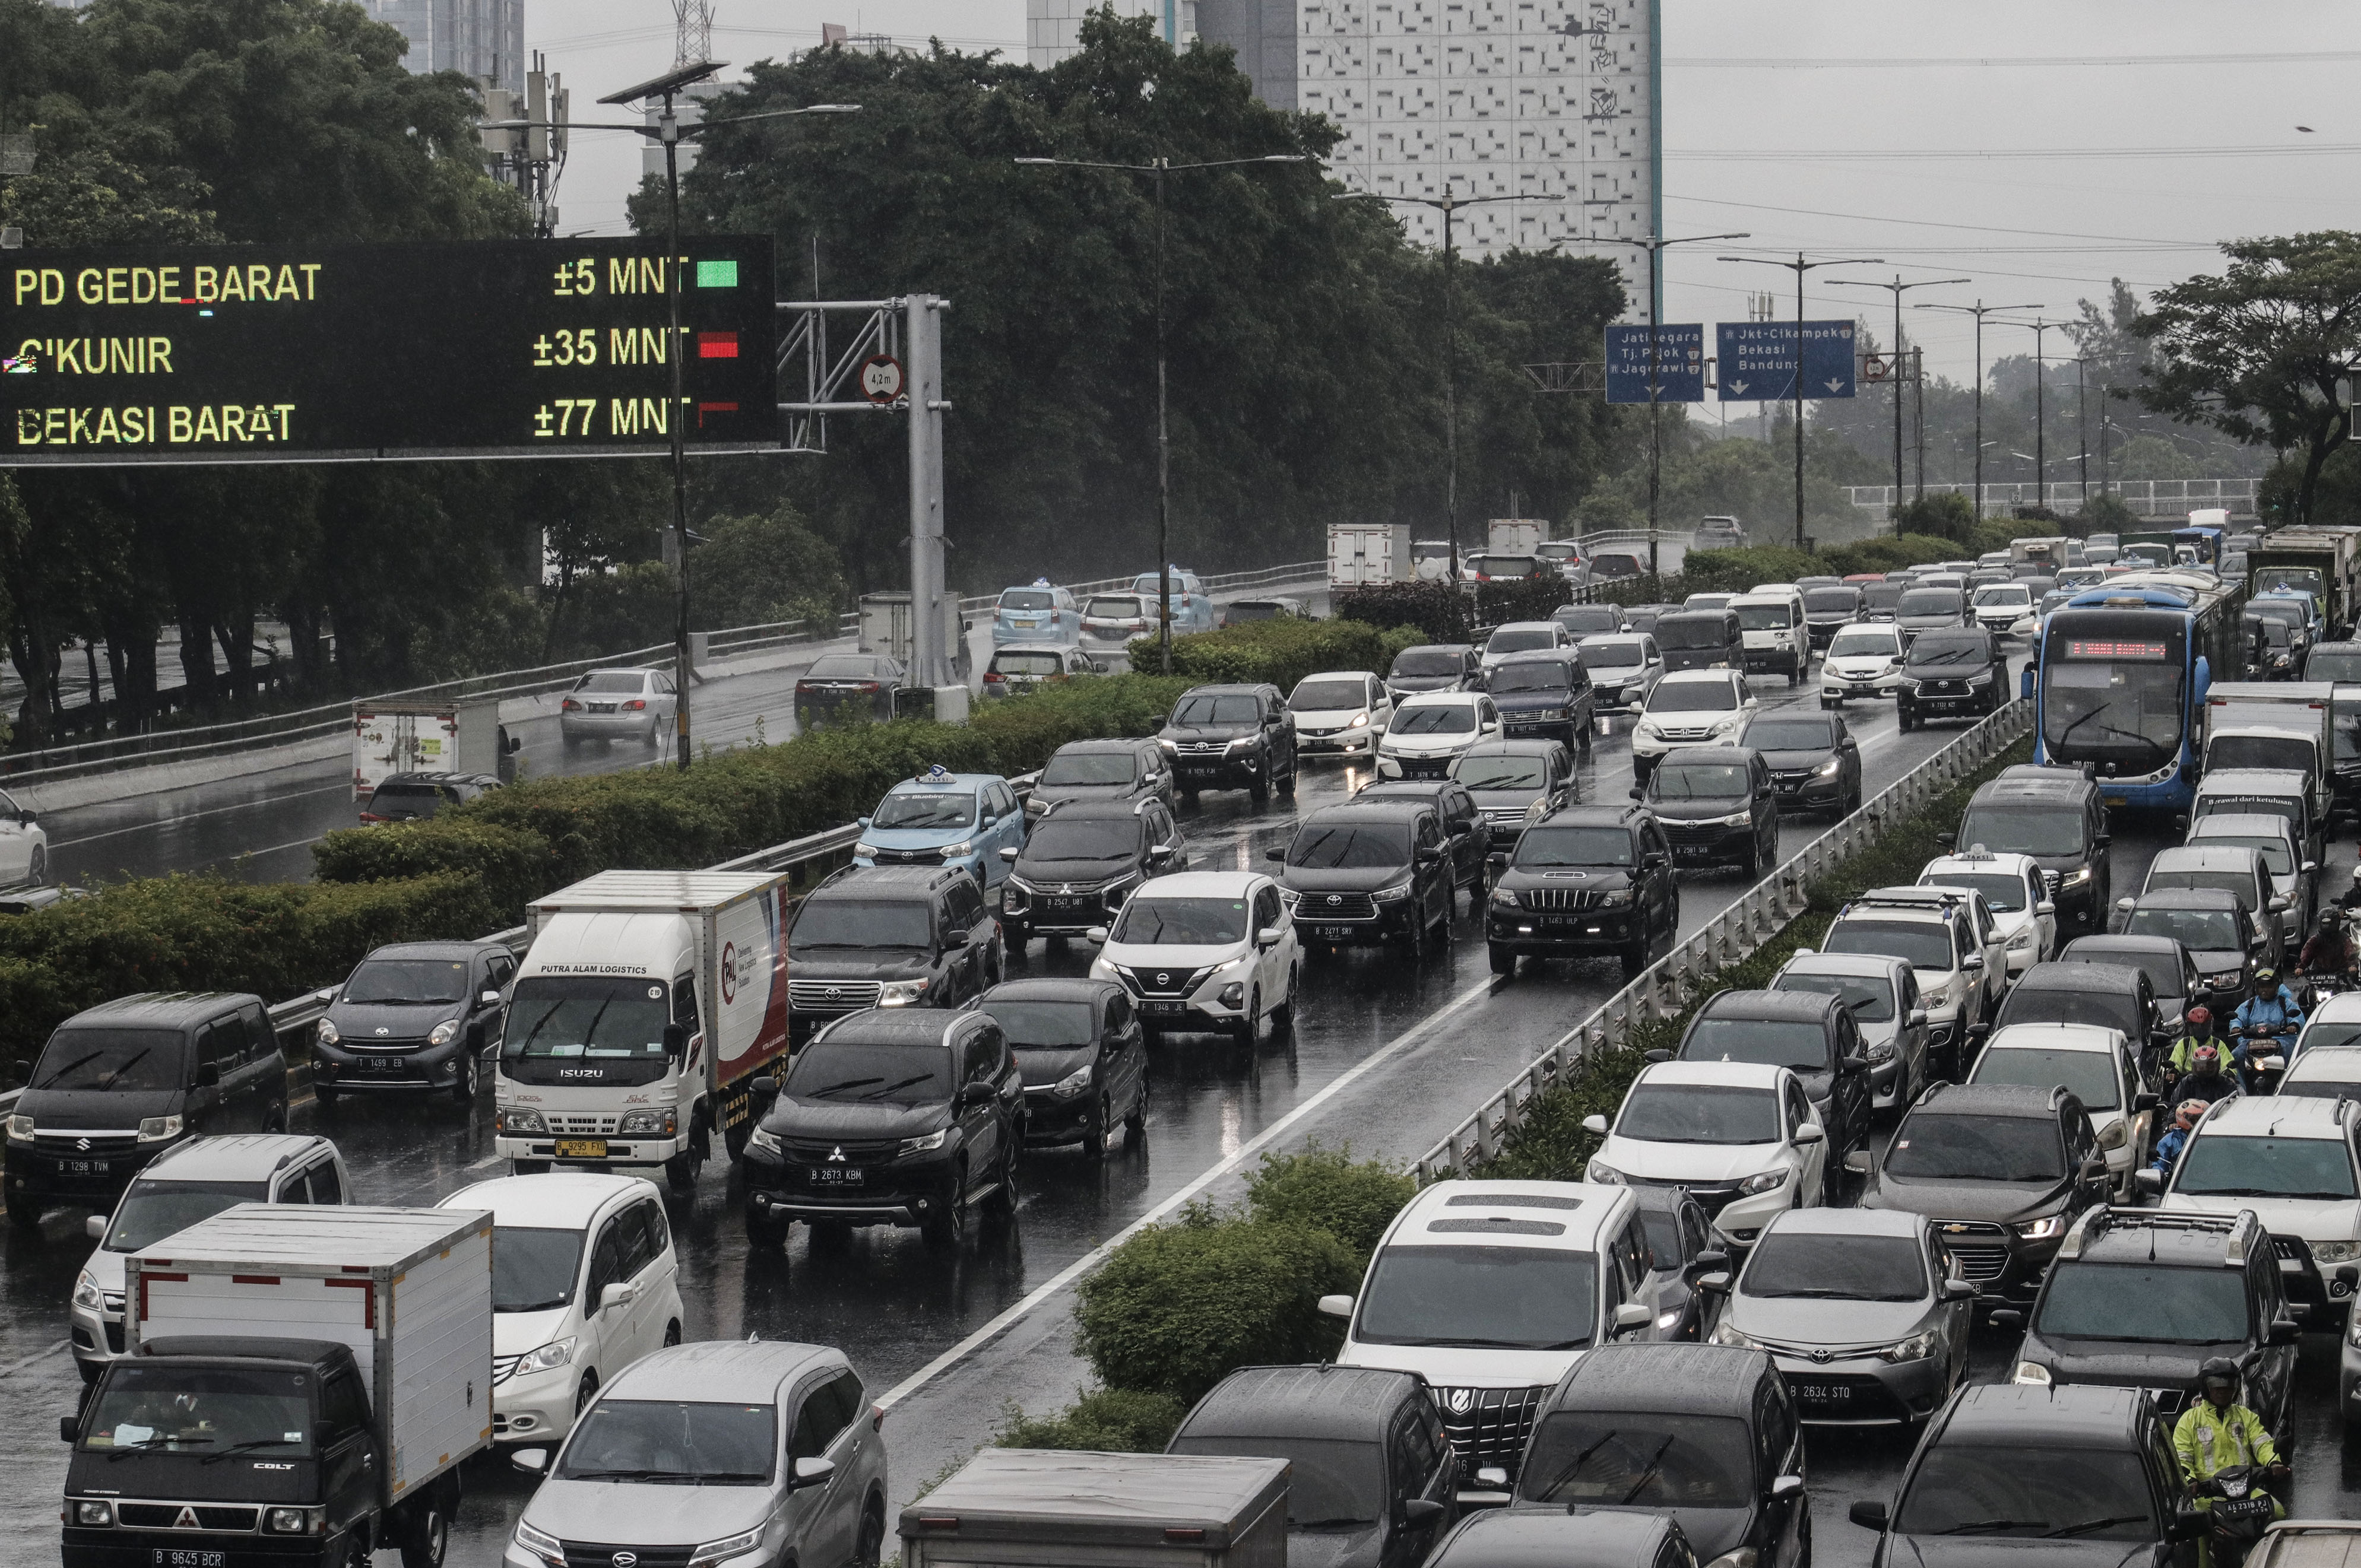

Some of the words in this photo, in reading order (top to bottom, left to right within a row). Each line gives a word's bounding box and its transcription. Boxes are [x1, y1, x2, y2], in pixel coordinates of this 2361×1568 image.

[554, 258, 595, 296] ±5
[15, 269, 65, 305] PD
[77, 266, 181, 305] GEDE
[195, 264, 321, 303] BARAT
[1621, 332, 1699, 345] Jatiegara
[1739, 328, 1839, 340] Jkt-Cikampek
[533, 329, 597, 366] ±35
[1642, 347, 1679, 359] Piok
[1739, 344, 1786, 355] Bekasi
[871, 374, 883, 386] 4,2
[885, 376, 891, 384] m
[534, 398, 596, 436] ±77
[18, 406, 155, 445] BEKASI
[169, 405, 295, 442] BARAT
[2208, 796, 2238, 805] Berawal
[2257, 796, 2292, 805] ketulusan
[725, 958, 737, 985] PAL
[811, 1021, 816, 1029] B
[820, 1021, 832, 1029] 80
[359, 1058, 363, 1067] T
[371, 1058, 386, 1067] 1499
[394, 1059, 402, 1067] EB
[560, 1069, 604, 1078] ISUZU
[557, 1141, 562, 1150] B
[569, 1141, 587, 1151] 9295
[591, 1142, 605, 1151] FXU
[59, 1161, 64, 1171] B
[71, 1161, 88, 1171] 1298
[94, 1161, 108, 1172] TVM
[812, 1170, 817, 1180] B
[822, 1170, 841, 1179] 2673
[846, 1170, 861, 1180] KBM
[1790, 1385, 1796, 1396] B
[1804, 1386, 1827, 1397] 2634
[1833, 1386, 1849, 1398] STQ
[2238, 1502, 2255, 1510] 2318
[156, 1551, 163, 1563] B
[172, 1552, 198, 1565] 9645
[202, 1553, 221, 1567] BCR
